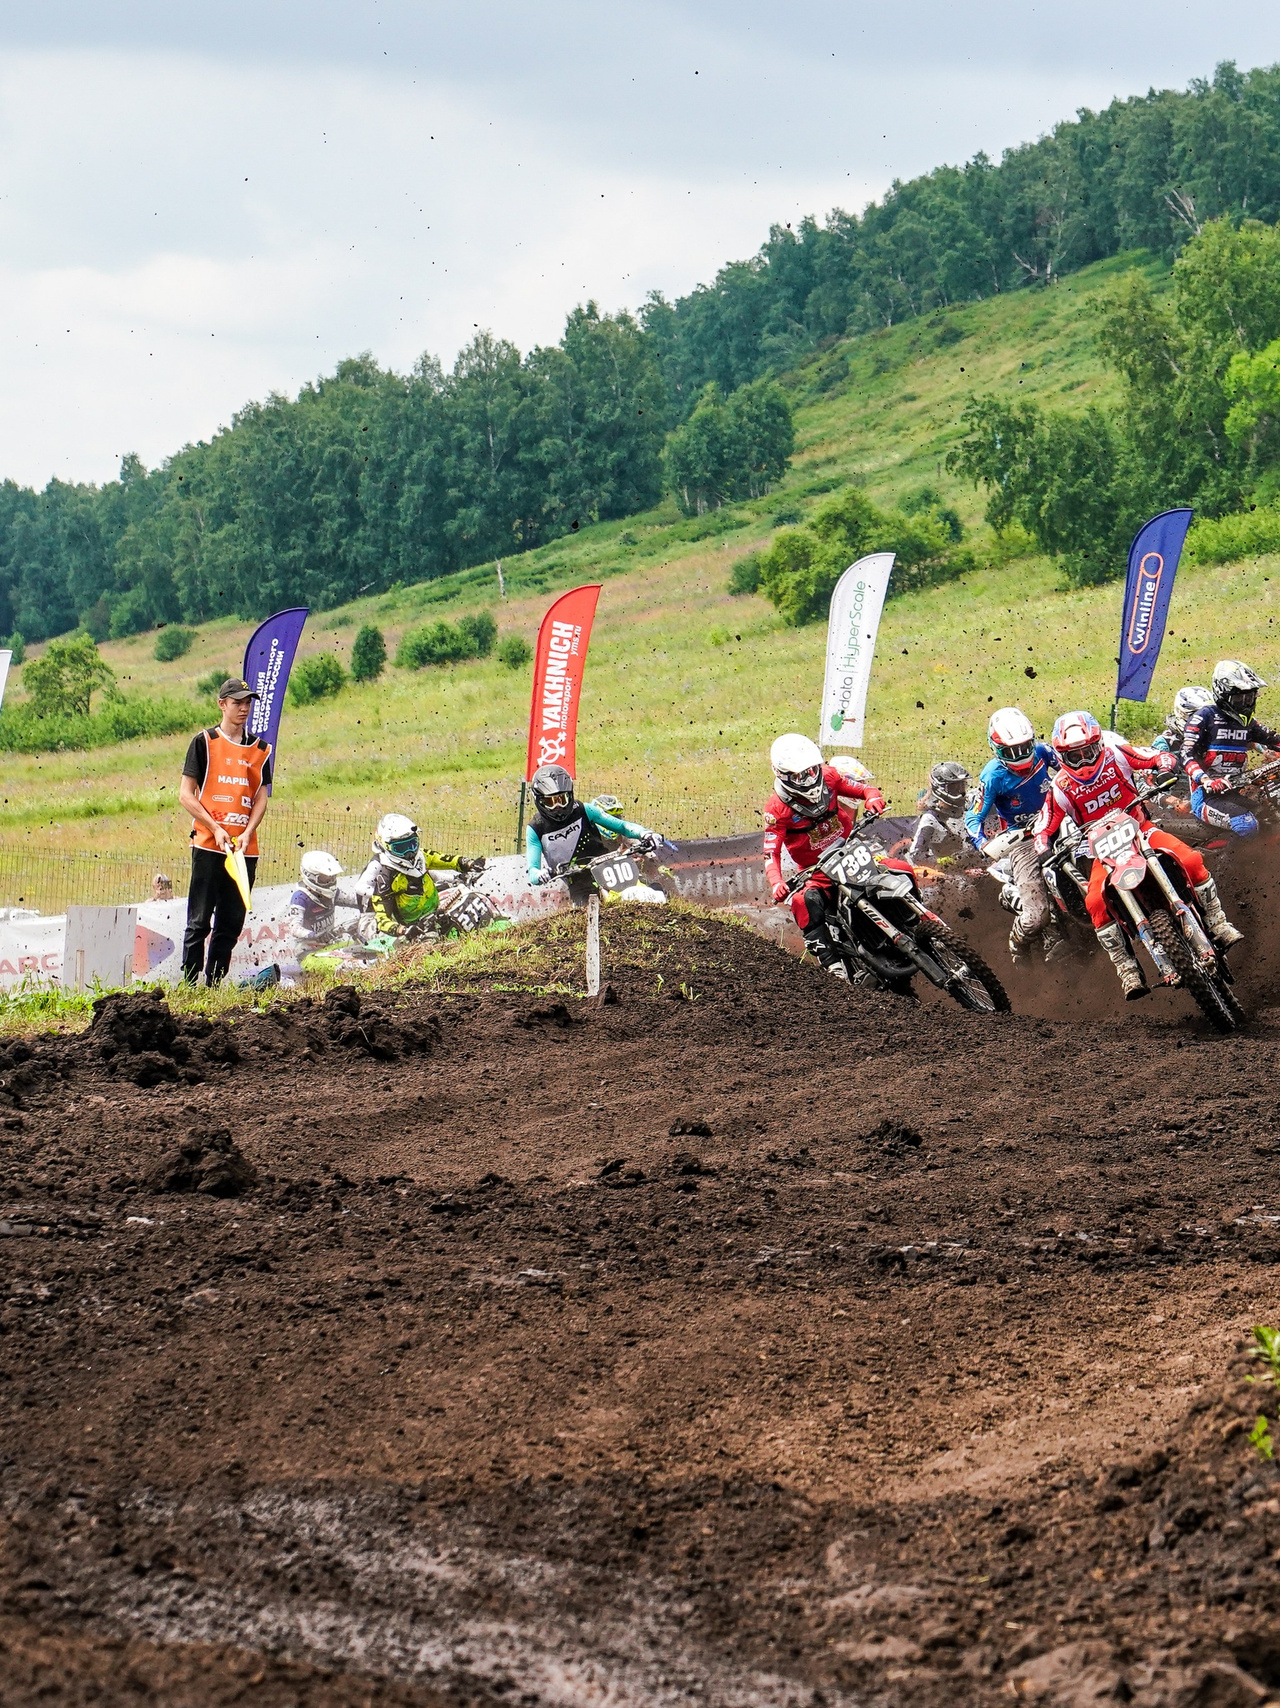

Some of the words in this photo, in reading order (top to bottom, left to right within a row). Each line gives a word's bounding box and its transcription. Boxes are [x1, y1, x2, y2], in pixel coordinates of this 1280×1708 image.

[570, 625, 583, 656] yms.ru
[842, 580, 866, 668] HyperScale
[257, 637, 279, 733] МОТОЦИКЛЕТНОГО
[268, 650, 285, 690] РОССИИ
[542, 620, 574, 731] YAKHNICH
[262, 692, 275, 732] СПОРТА
[560, 677, 573, 730] motorsport
[838, 676, 854, 710] data
[1216, 728, 1248, 741] SHOT
[1084, 783, 1121, 815] DRC
[1094, 822, 1136, 860] 500
[602, 861, 634, 888] 910
[830, 845, 872, 885] 738
